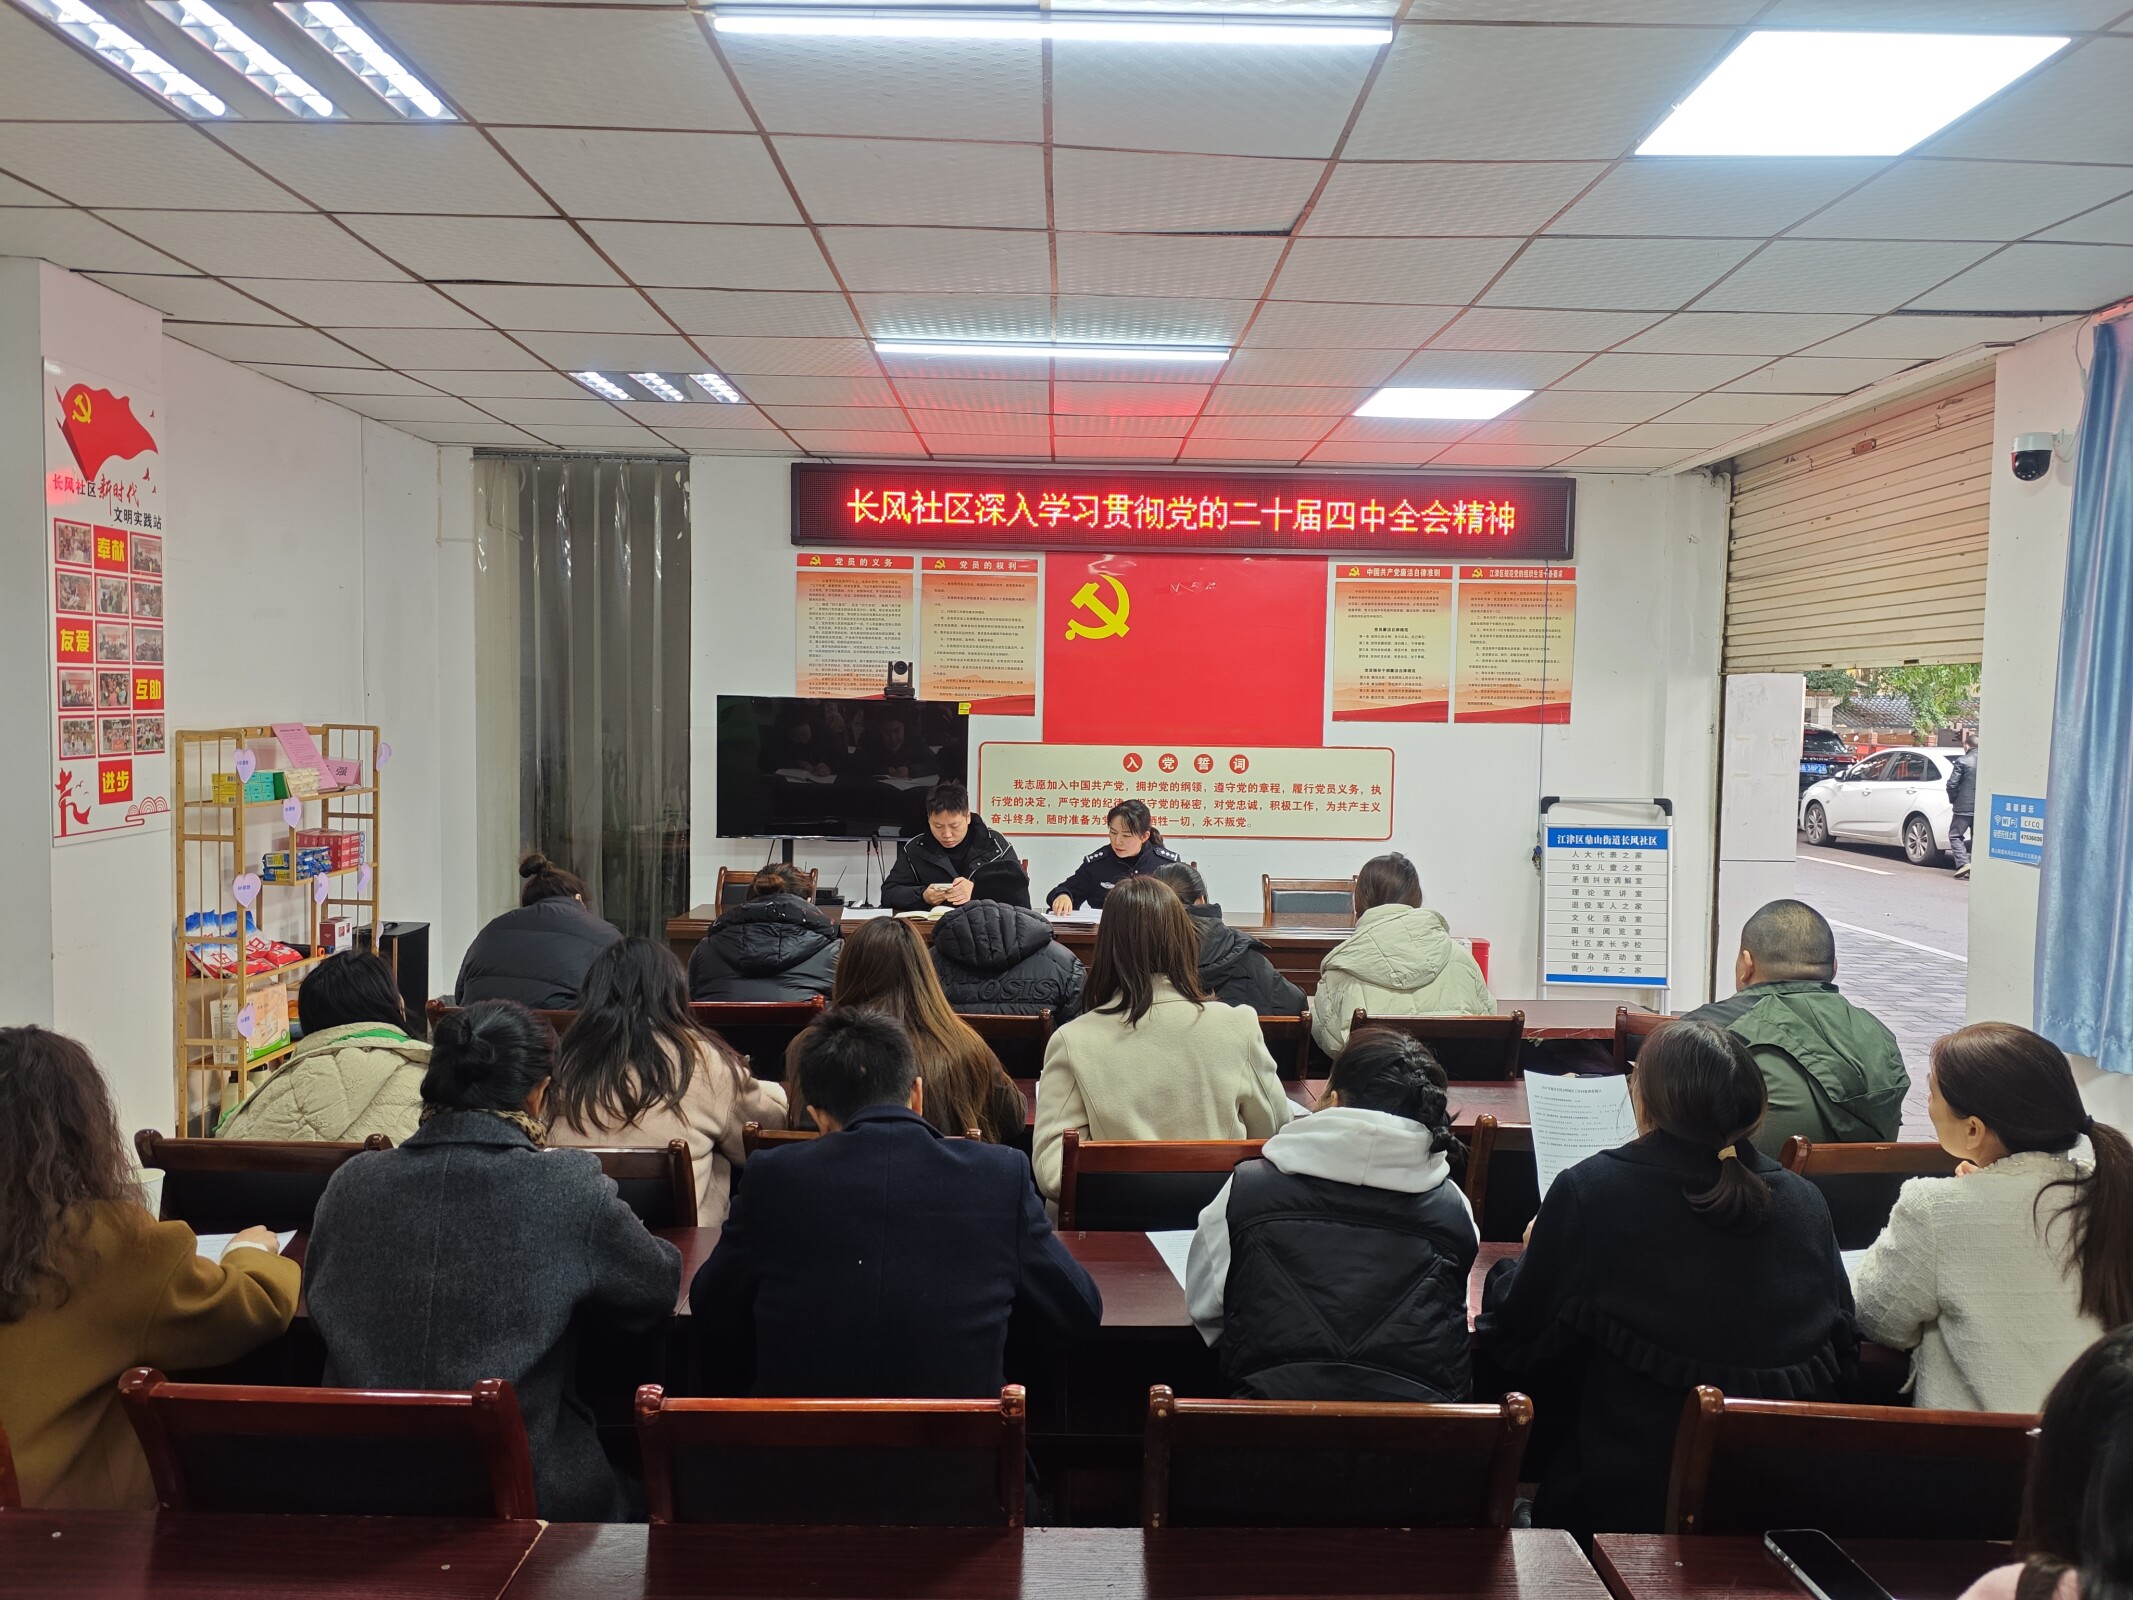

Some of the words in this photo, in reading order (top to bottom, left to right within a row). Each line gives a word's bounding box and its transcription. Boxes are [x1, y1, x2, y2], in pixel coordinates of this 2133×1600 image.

[846, 487, 1516, 536] 长风社区深入学习贯彻党的二十届四中全会精神
[113, 506, 162, 531] 文明实践站
[97, 537, 125, 562] 奉献
[834, 556, 893, 568] 党员的义务
[959, 560, 1017, 571] 党员的权利
[1366, 567, 1441, 577] 中国共产党廉洁自律准则
[60, 628, 90, 653] 友爱
[135, 678, 162, 700] 互助
[1125, 756, 1247, 772] 入党誓词
[102, 770, 130, 794] 进步
[1557, 834, 1658, 846] 江津区鼎山街道长风社区
[1571, 850, 1643, 859] 人大代表之家
[1571, 863, 1643, 872] 妇女儿童之家
[1571, 876, 1643, 885] 矛盾纠纷调解室
[1571, 889, 1643, 898] 理论宣讲室
[1571, 901, 1643, 911] 退役军人之家
[1571, 914, 1643, 923] 文化活动室
[1571, 927, 1643, 936] 图书阅览室
[1571, 939, 1643, 949] 社区家长学校
[1571, 952, 1643, 962] 健身活动室
[1571, 965, 1643, 974] 青少年之家
